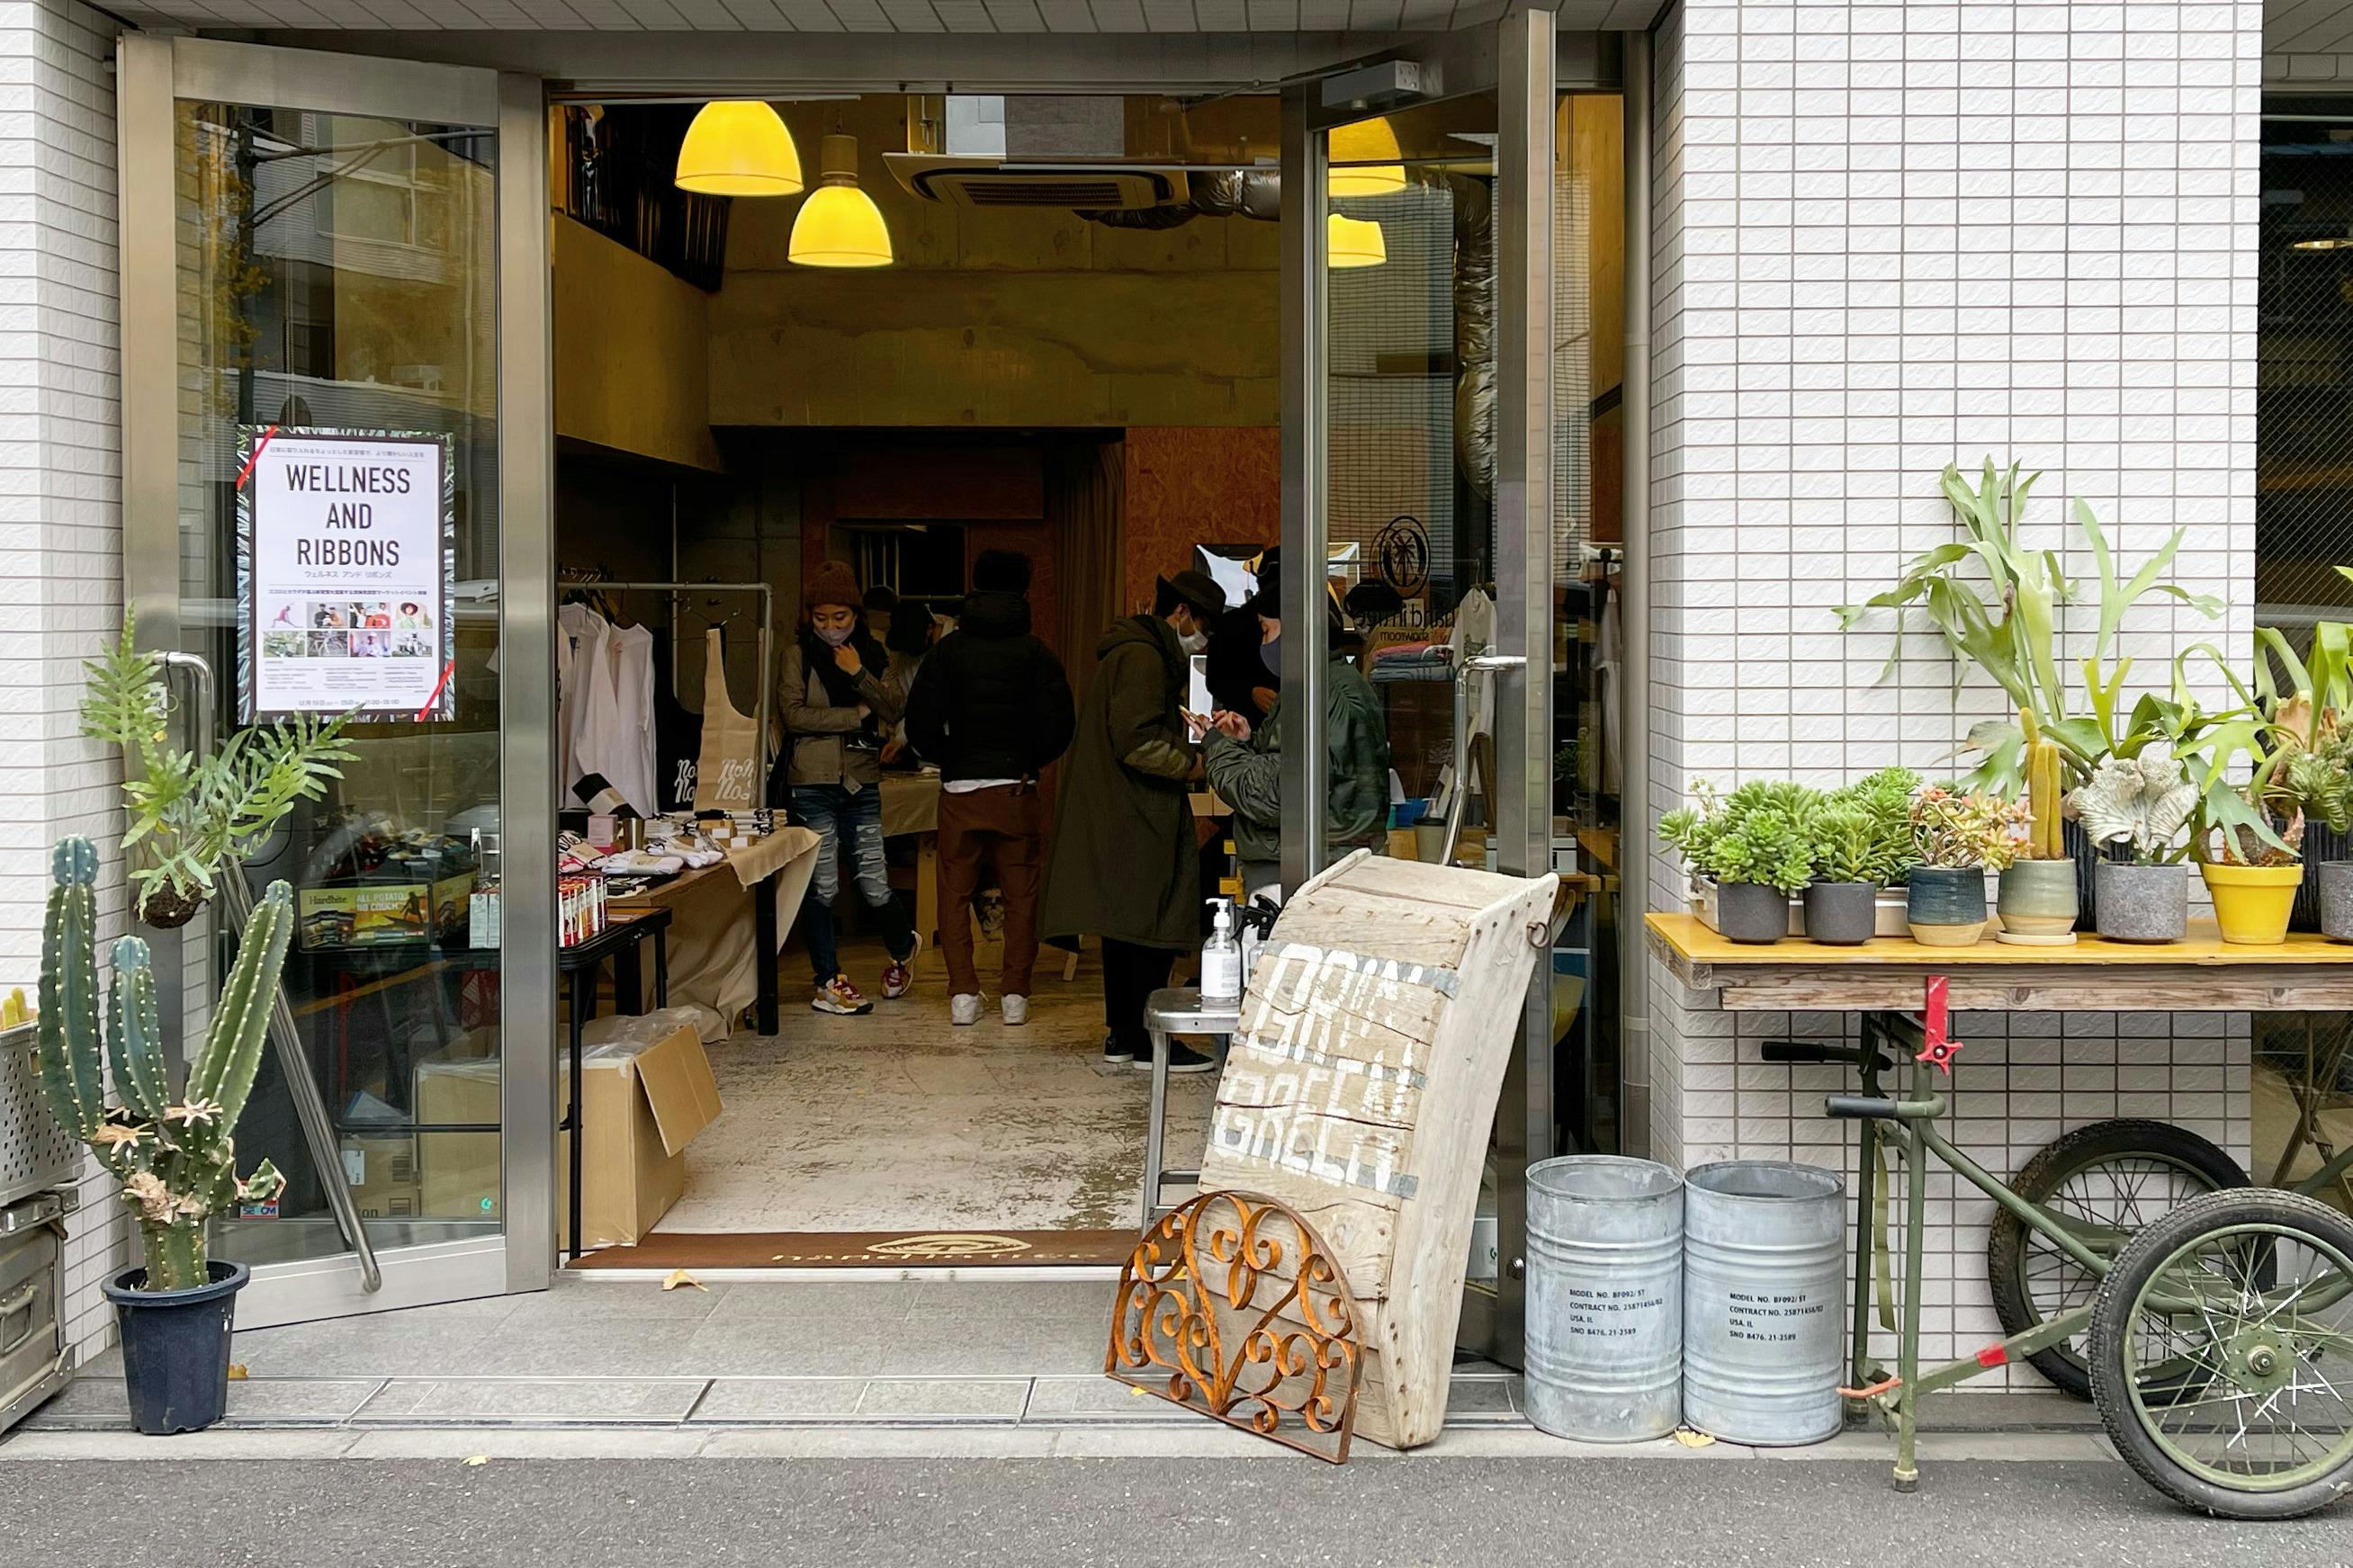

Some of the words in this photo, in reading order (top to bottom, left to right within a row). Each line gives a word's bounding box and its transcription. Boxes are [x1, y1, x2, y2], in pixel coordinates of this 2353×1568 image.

[285, 463, 410, 494] WELLNESS
[325, 502, 372, 529] AND
[297, 538, 400, 567] RIBBONS
[310, 893, 347, 905] Hardbite
[1215, 1042, 1414, 1192] GREEN
[1569, 1289, 1594, 1298] MODEL
[1596, 1291, 1611, 1299] NO.
[1729, 1292, 1755, 1303] MODEL
[1756, 1295, 1771, 1304] NO.
[1569, 1302, 1606, 1312] CONTRACT
[1607, 1304, 1621, 1312] NO.
[1729, 1305, 1767, 1316] CONTRACT
[1768, 1309, 1782, 1317] NO.
